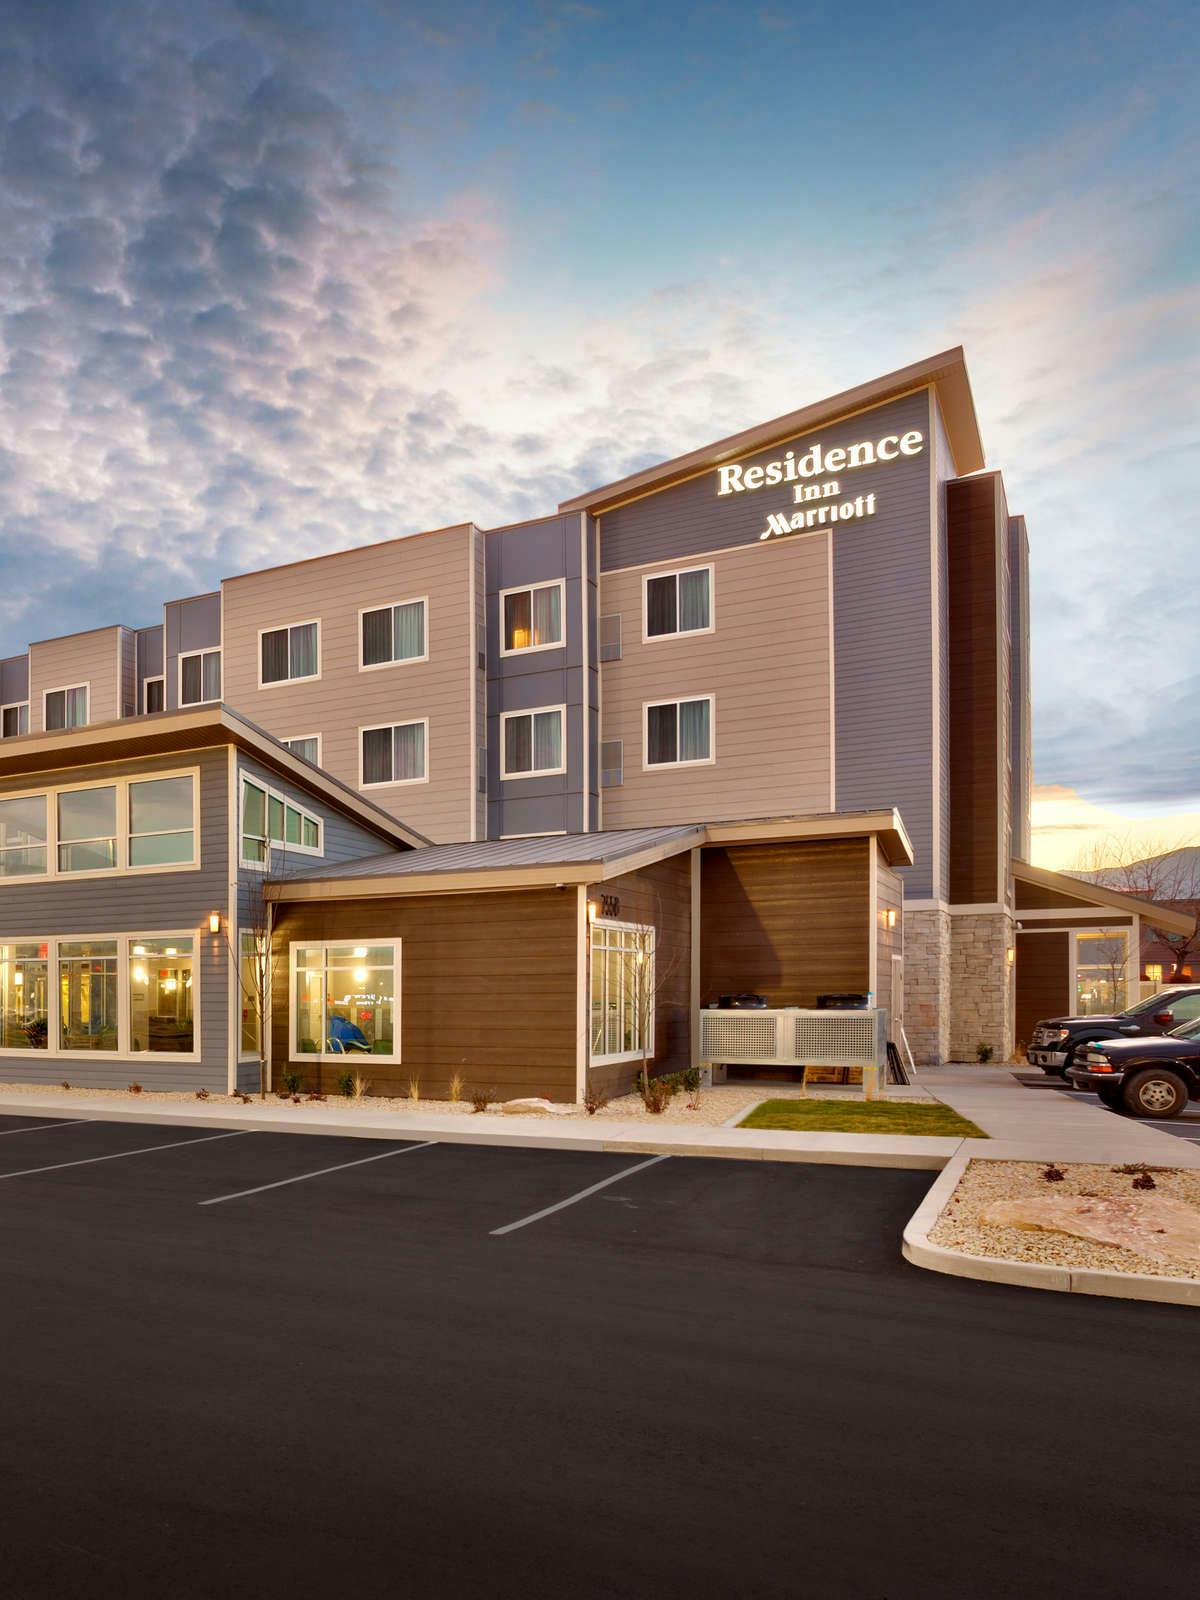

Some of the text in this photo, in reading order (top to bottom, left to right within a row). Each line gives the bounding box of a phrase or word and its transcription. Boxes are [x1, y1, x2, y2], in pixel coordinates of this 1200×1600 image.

[717, 431, 923, 496] Residence
[759, 492, 876, 540] Marriott
[793, 480, 841, 504] Inn
